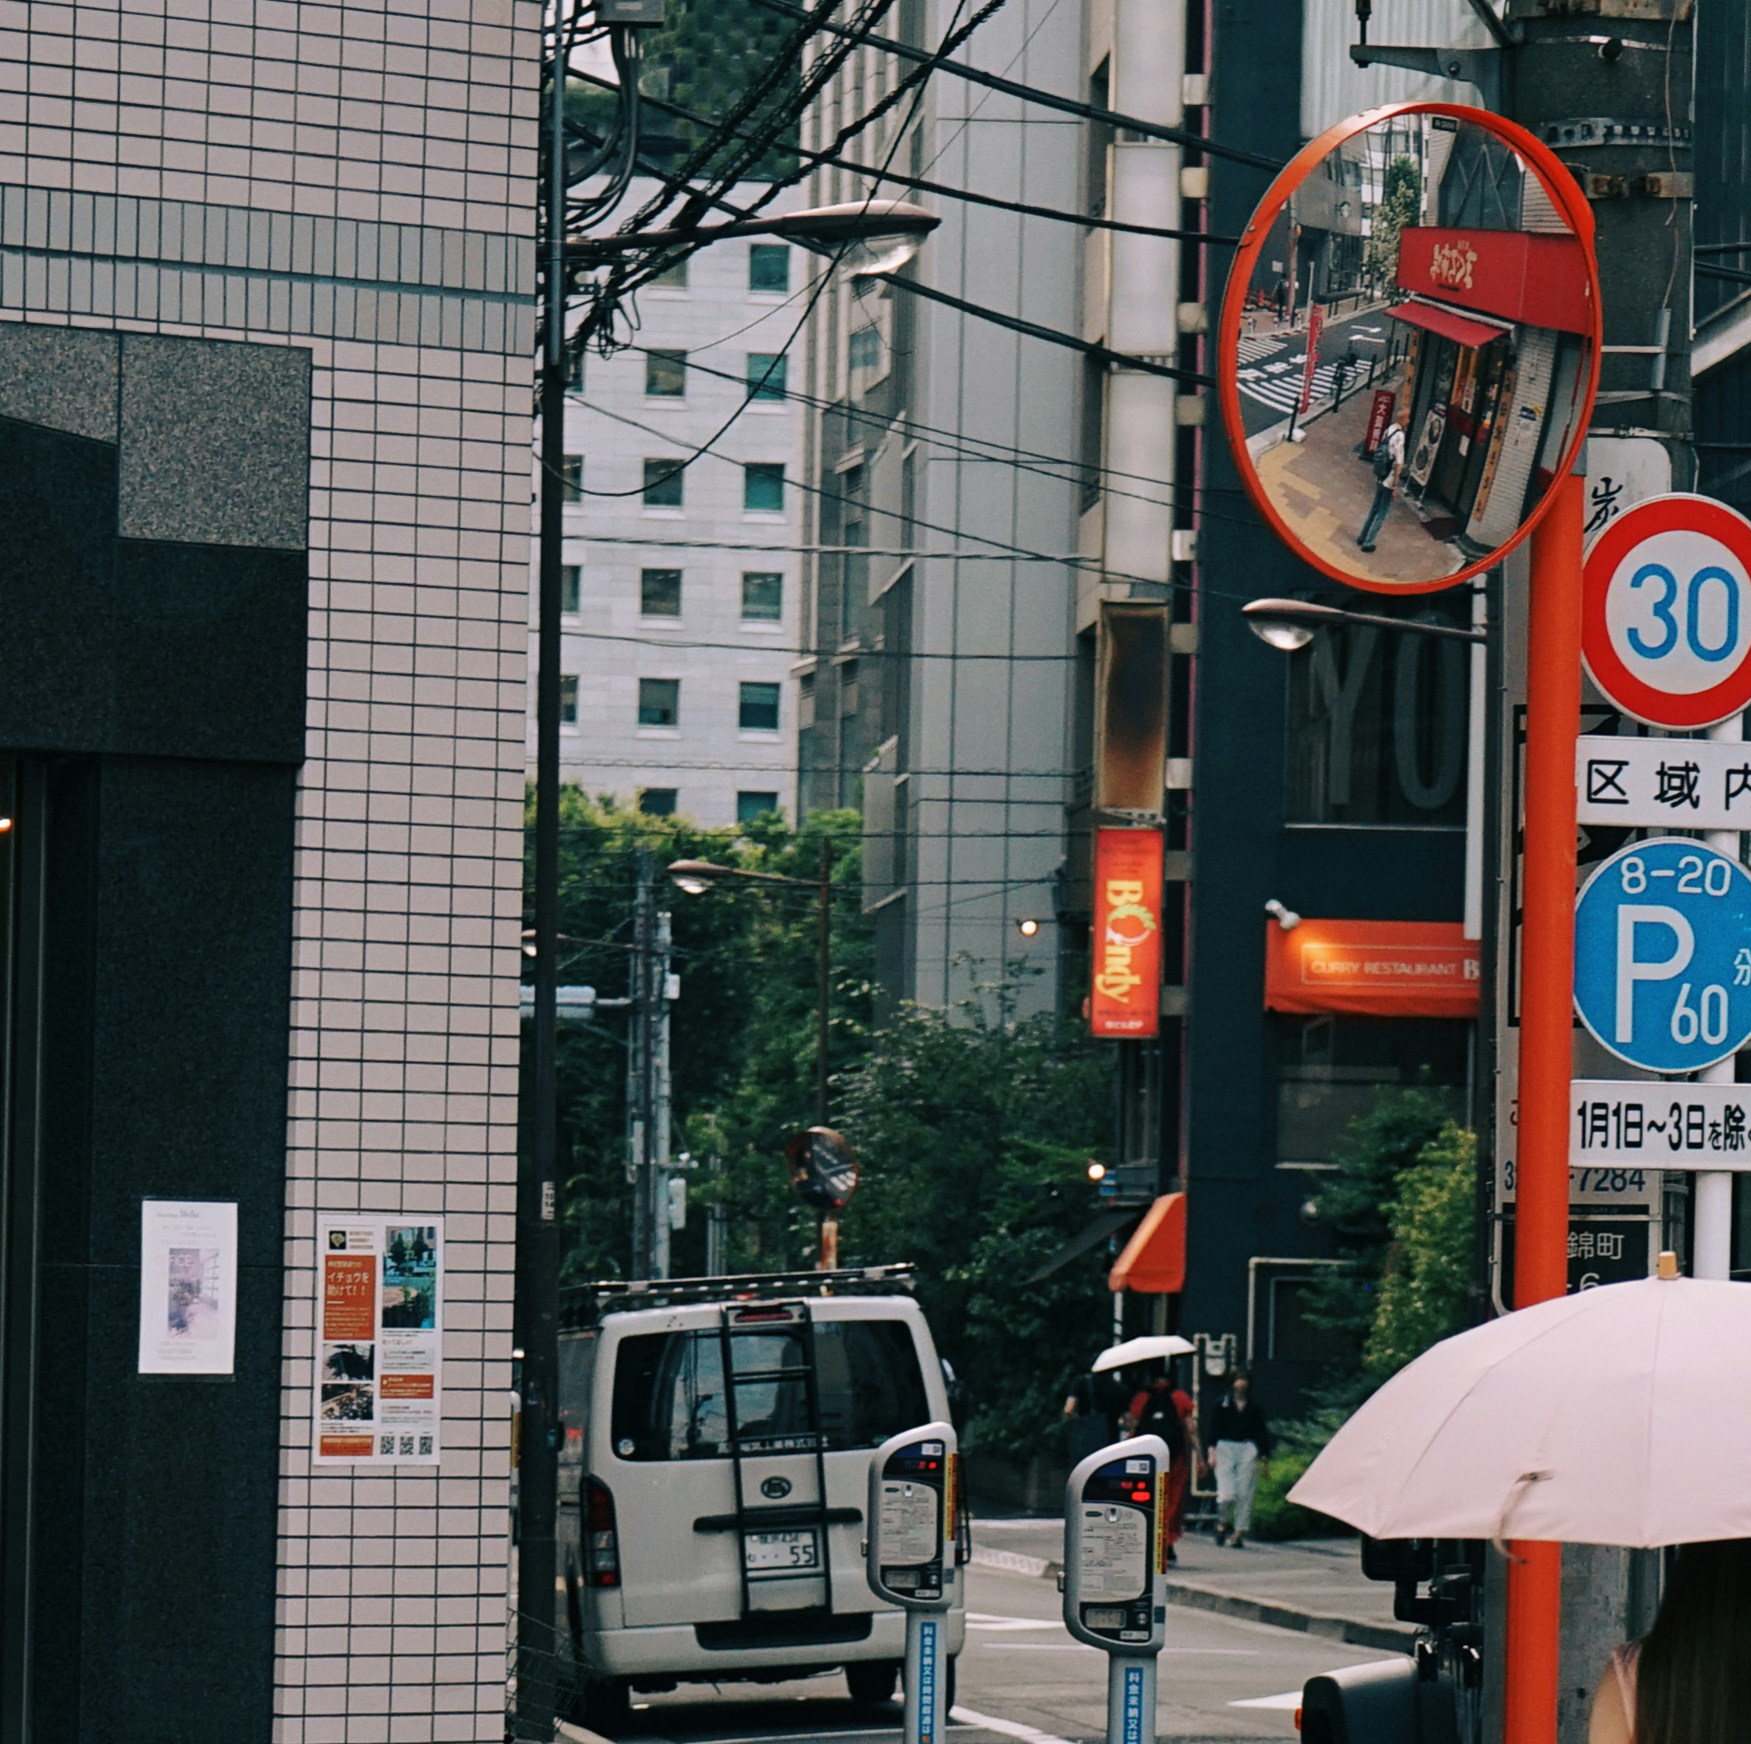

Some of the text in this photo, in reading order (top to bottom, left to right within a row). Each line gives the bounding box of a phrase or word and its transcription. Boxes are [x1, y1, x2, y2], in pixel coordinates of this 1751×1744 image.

[1627, 563, 1740, 662] 30
[1621, 856, 1731, 896] 8-20
[1311, 961, 1360, 974] CURRY
[1364, 962, 1456, 975] RESTAURANT
[1615, 904, 1695, 1043] P
[1671, 983, 1729, 1045] 60
[790, 1545, 814, 1564] 55
